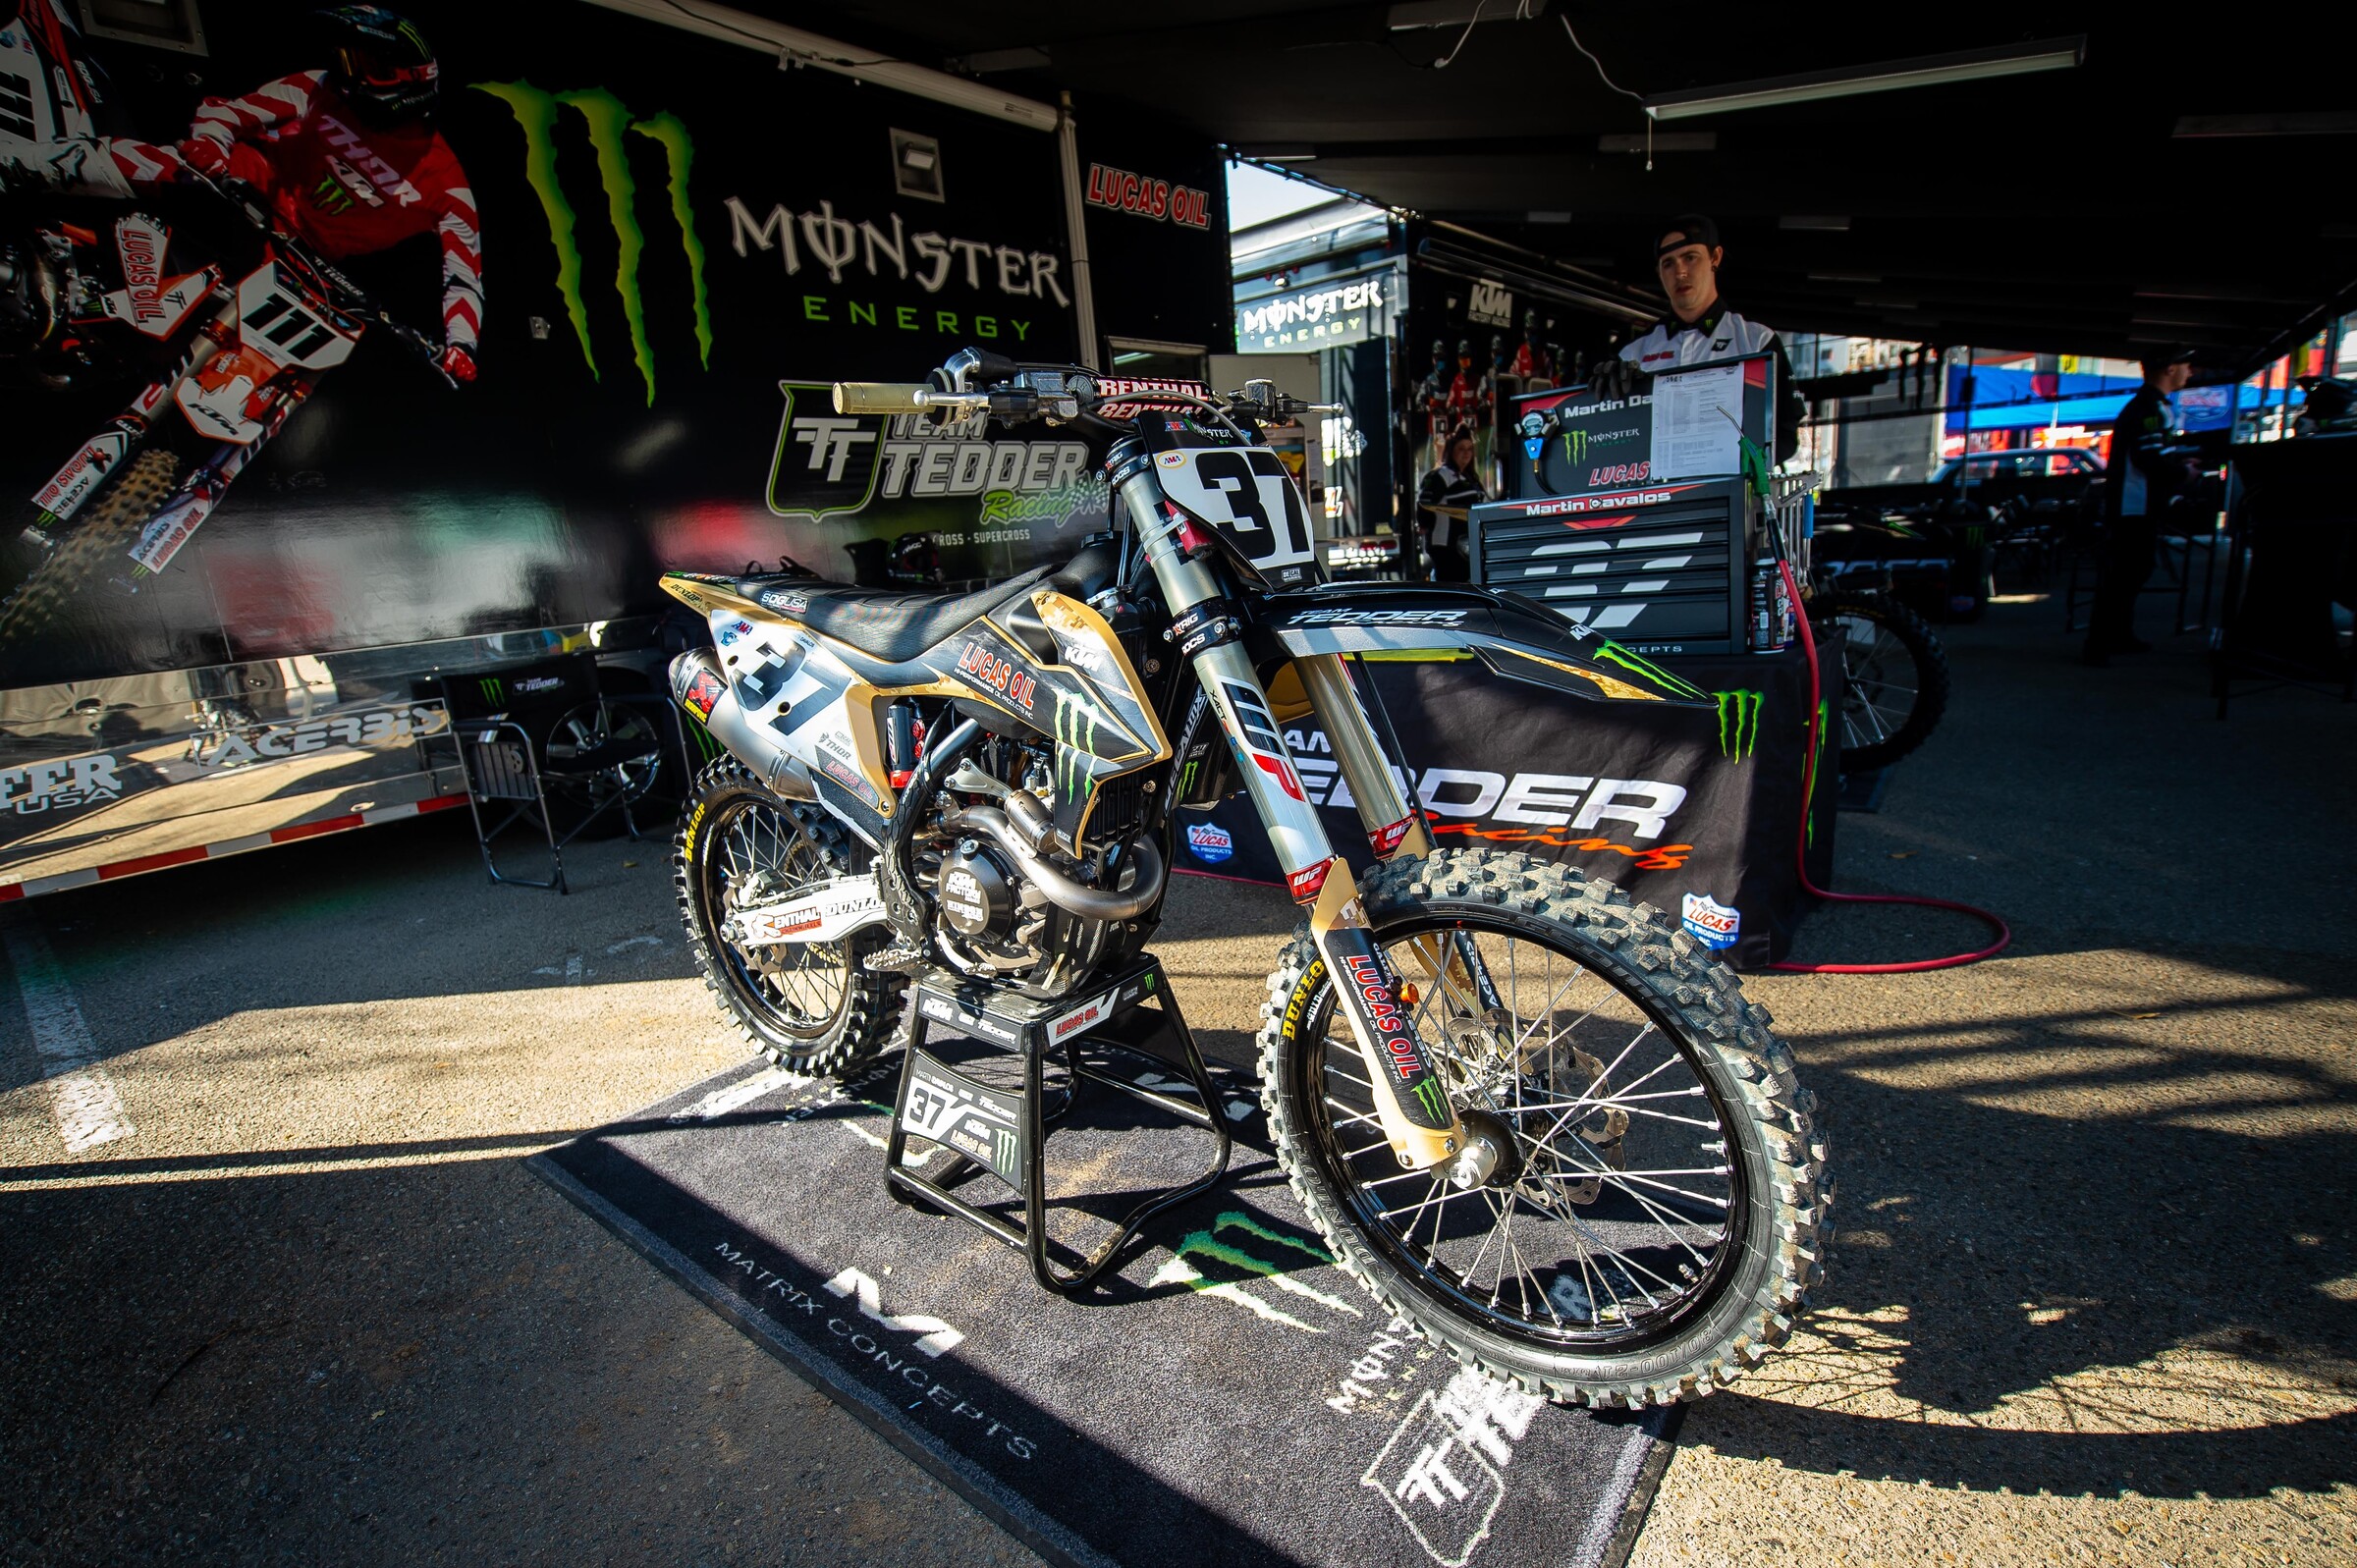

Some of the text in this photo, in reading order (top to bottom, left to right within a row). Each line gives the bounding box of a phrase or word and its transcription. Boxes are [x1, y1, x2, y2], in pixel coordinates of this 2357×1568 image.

[1086, 163, 1212, 230] LUCAS OIL
[725, 195, 1070, 308] MONSTER
[119, 227, 167, 324] LUCAS OIL
[1243, 281, 1383, 335] MONSTER
[1469, 277, 1513, 318] KTM
[242, 293, 337, 361] 111
[803, 295, 1031, 342] ENERGY
[1263, 317, 1360, 349] ENERGY
[1098, 378, 1209, 402] RENTHAL
[1564, 397, 1624, 419] Martin
[891, 410, 987, 440] TEAM
[1587, 427, 1640, 444] MONSTER
[882, 441, 1088, 499] TEDDER
[1588, 460, 1650, 486] LUCAS
[980, 489, 1074, 528] Racing
[1194, 451, 1311, 561] 37
[1526, 496, 1585, 516] Martin
[973, 528, 1031, 546] SUPERCROSS
[1172, 612, 1199, 636] XTRIG
[1287, 610, 1468, 624] TEDDER
[1064, 645, 1105, 673] KTM
[958, 641, 1037, 711] LUCAS OIL
[1001, 693, 1026, 716] PRODUCTS
[207, 706, 441, 767] ACERBIS
[825, 738, 852, 761] THOR
[825, 759, 873, 800] LUCAS OIL
[16, 787, 122, 815] USA
[685, 802, 707, 863] DUNLOP
[1192, 834, 1230, 846] LUCAS
[1201, 846, 1233, 856] PRODUCTS
[1682, 920, 1736, 943] OIL PRODUCTS
[1688, 908, 1736, 932] LUCAS
[1282, 959, 1326, 1041] DUNLO
[1339, 955, 1373, 1019] HI-PERFORMANCE
[1375, 1032, 1395, 1069] PRODUCTS
[1056, 1004, 1099, 1036] LUCAS OIL
[1345, 954, 1422, 1080] LUCAS OIL
[908, 1087, 947, 1130] 37
[950, 1129, 993, 1160] LUCAS OIL
[714, 1241, 1038, 1461] MATRIX CONCEPTS
